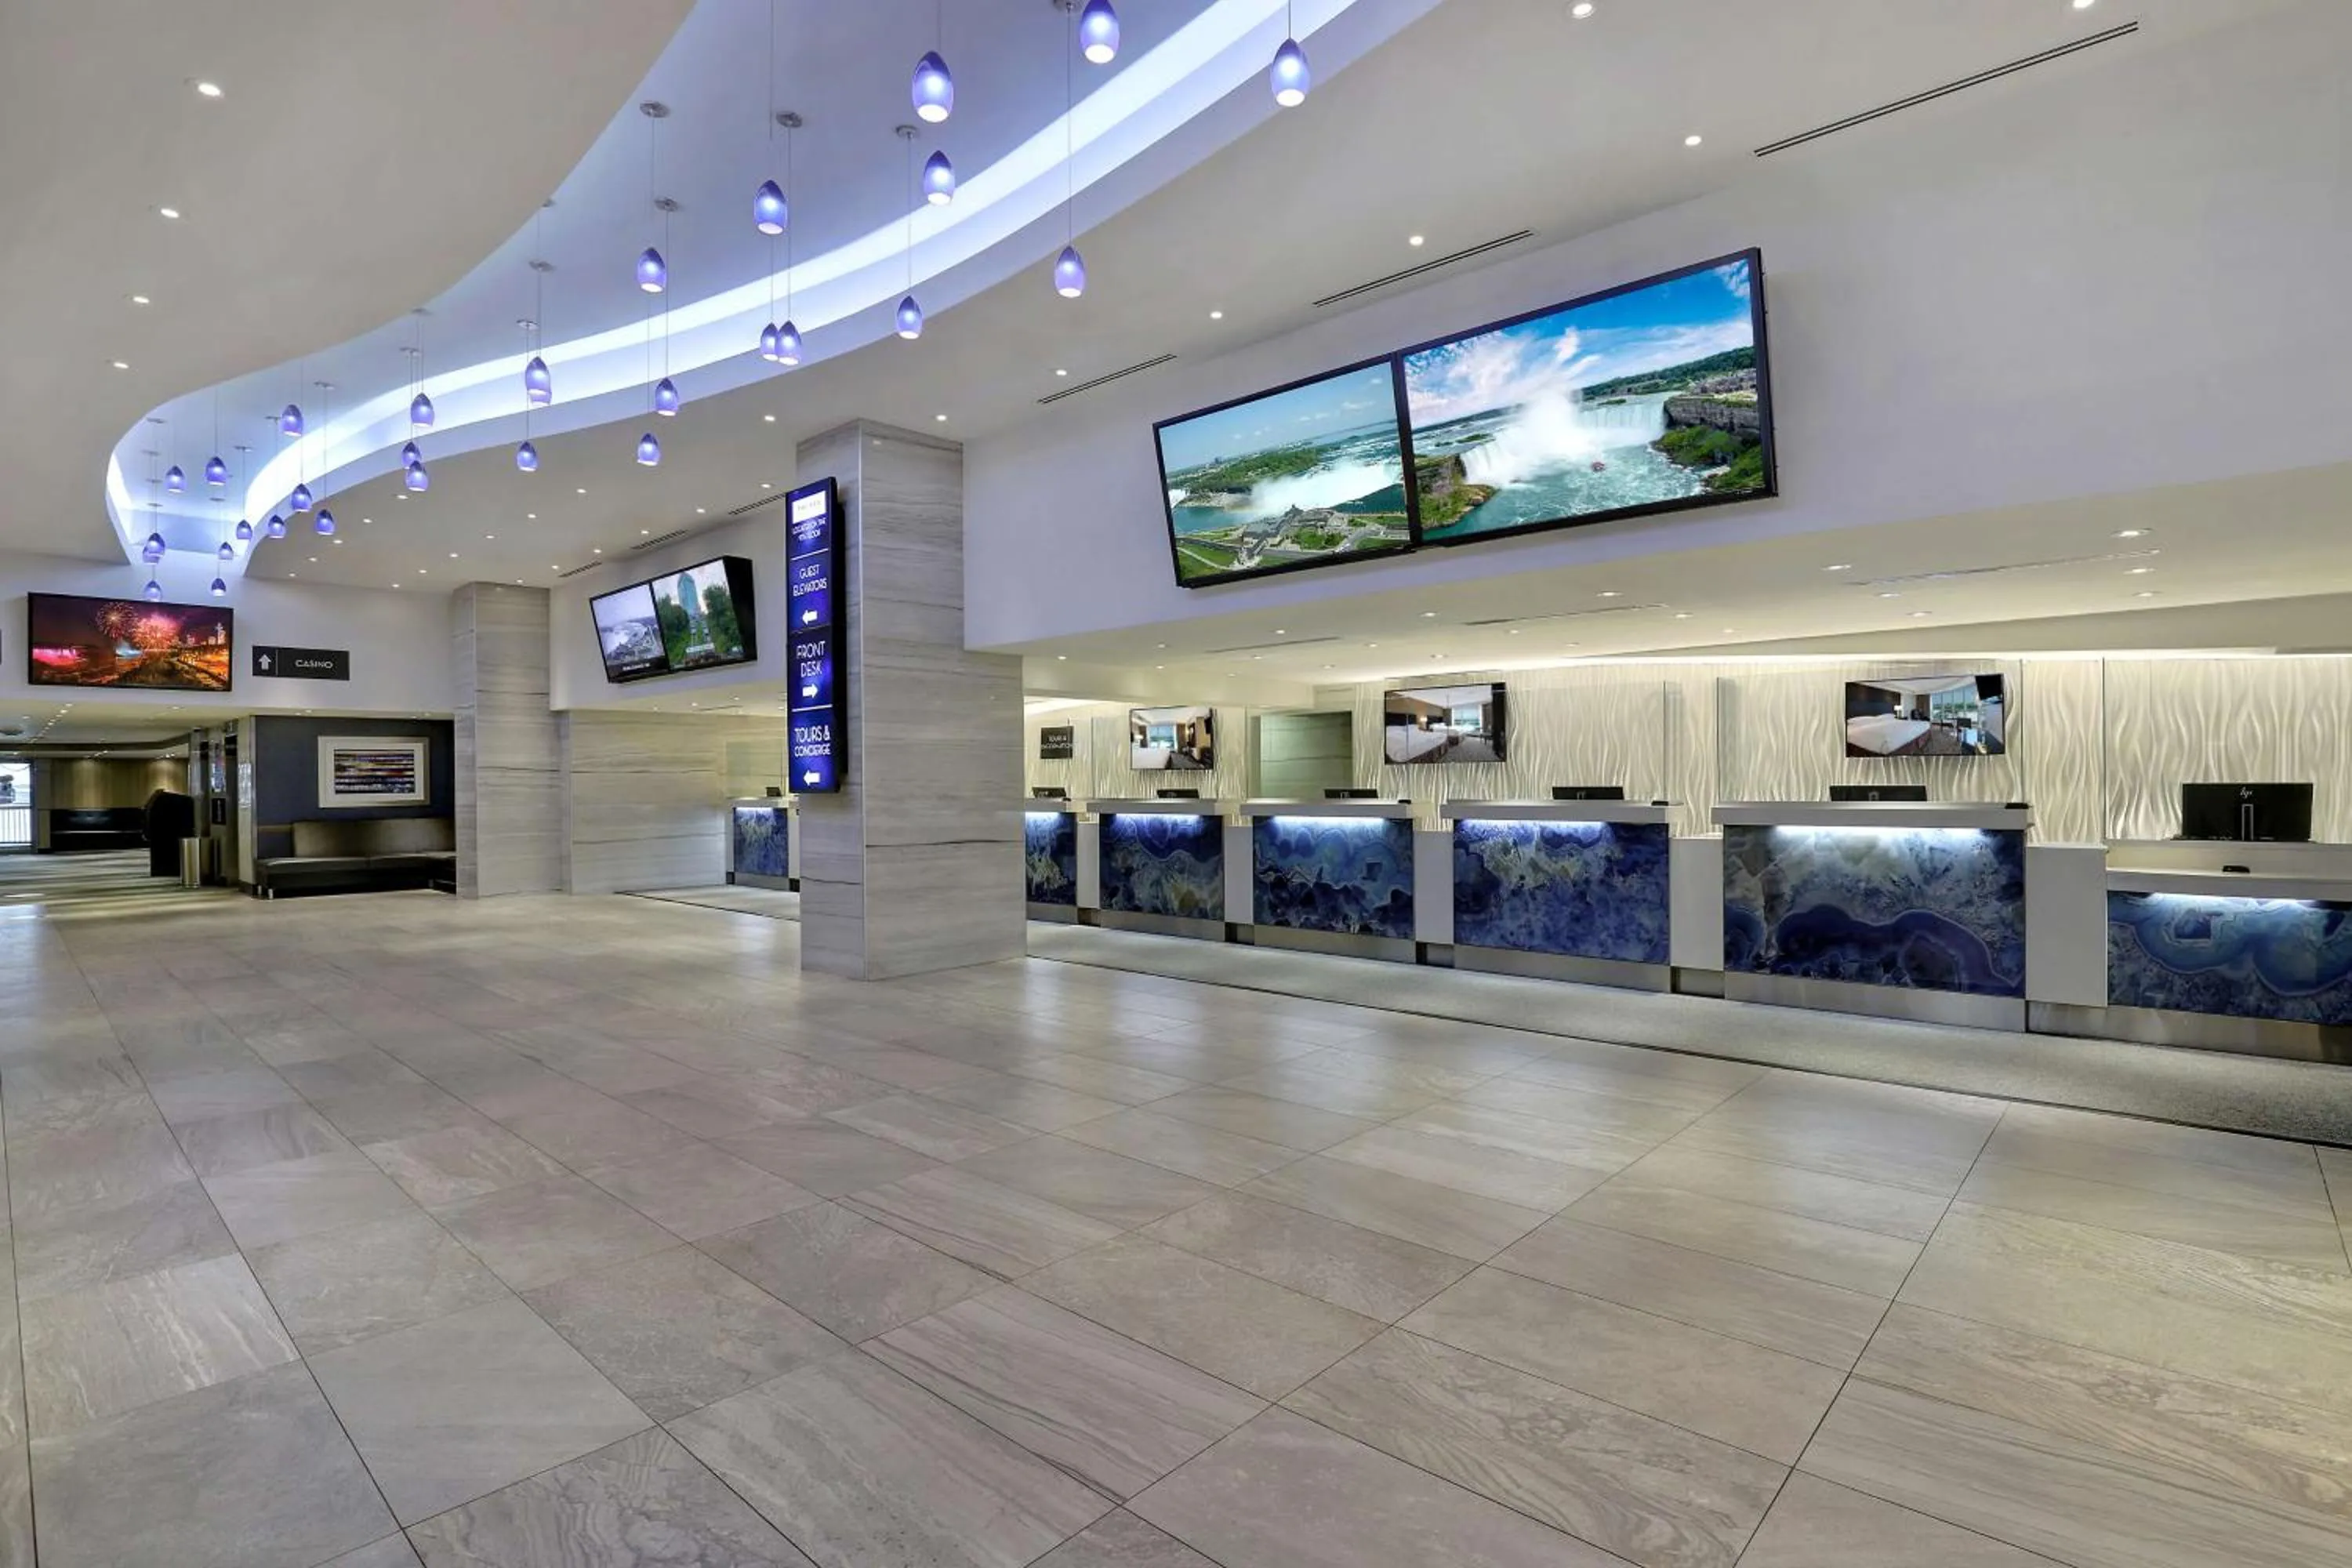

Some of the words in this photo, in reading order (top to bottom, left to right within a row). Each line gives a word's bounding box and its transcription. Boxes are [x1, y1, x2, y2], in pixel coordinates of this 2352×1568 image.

[800, 564, 819, 579] GUEST
[793, 578, 827, 597] ELEVATORS
[797, 640, 826, 659] FRONT
[295, 659, 333, 669] CASINO
[800, 660, 822, 678] DESK
[794, 725, 822, 743] TOURS
[823, 724, 830, 741] &
[794, 743, 831, 757] CONCIERGE
